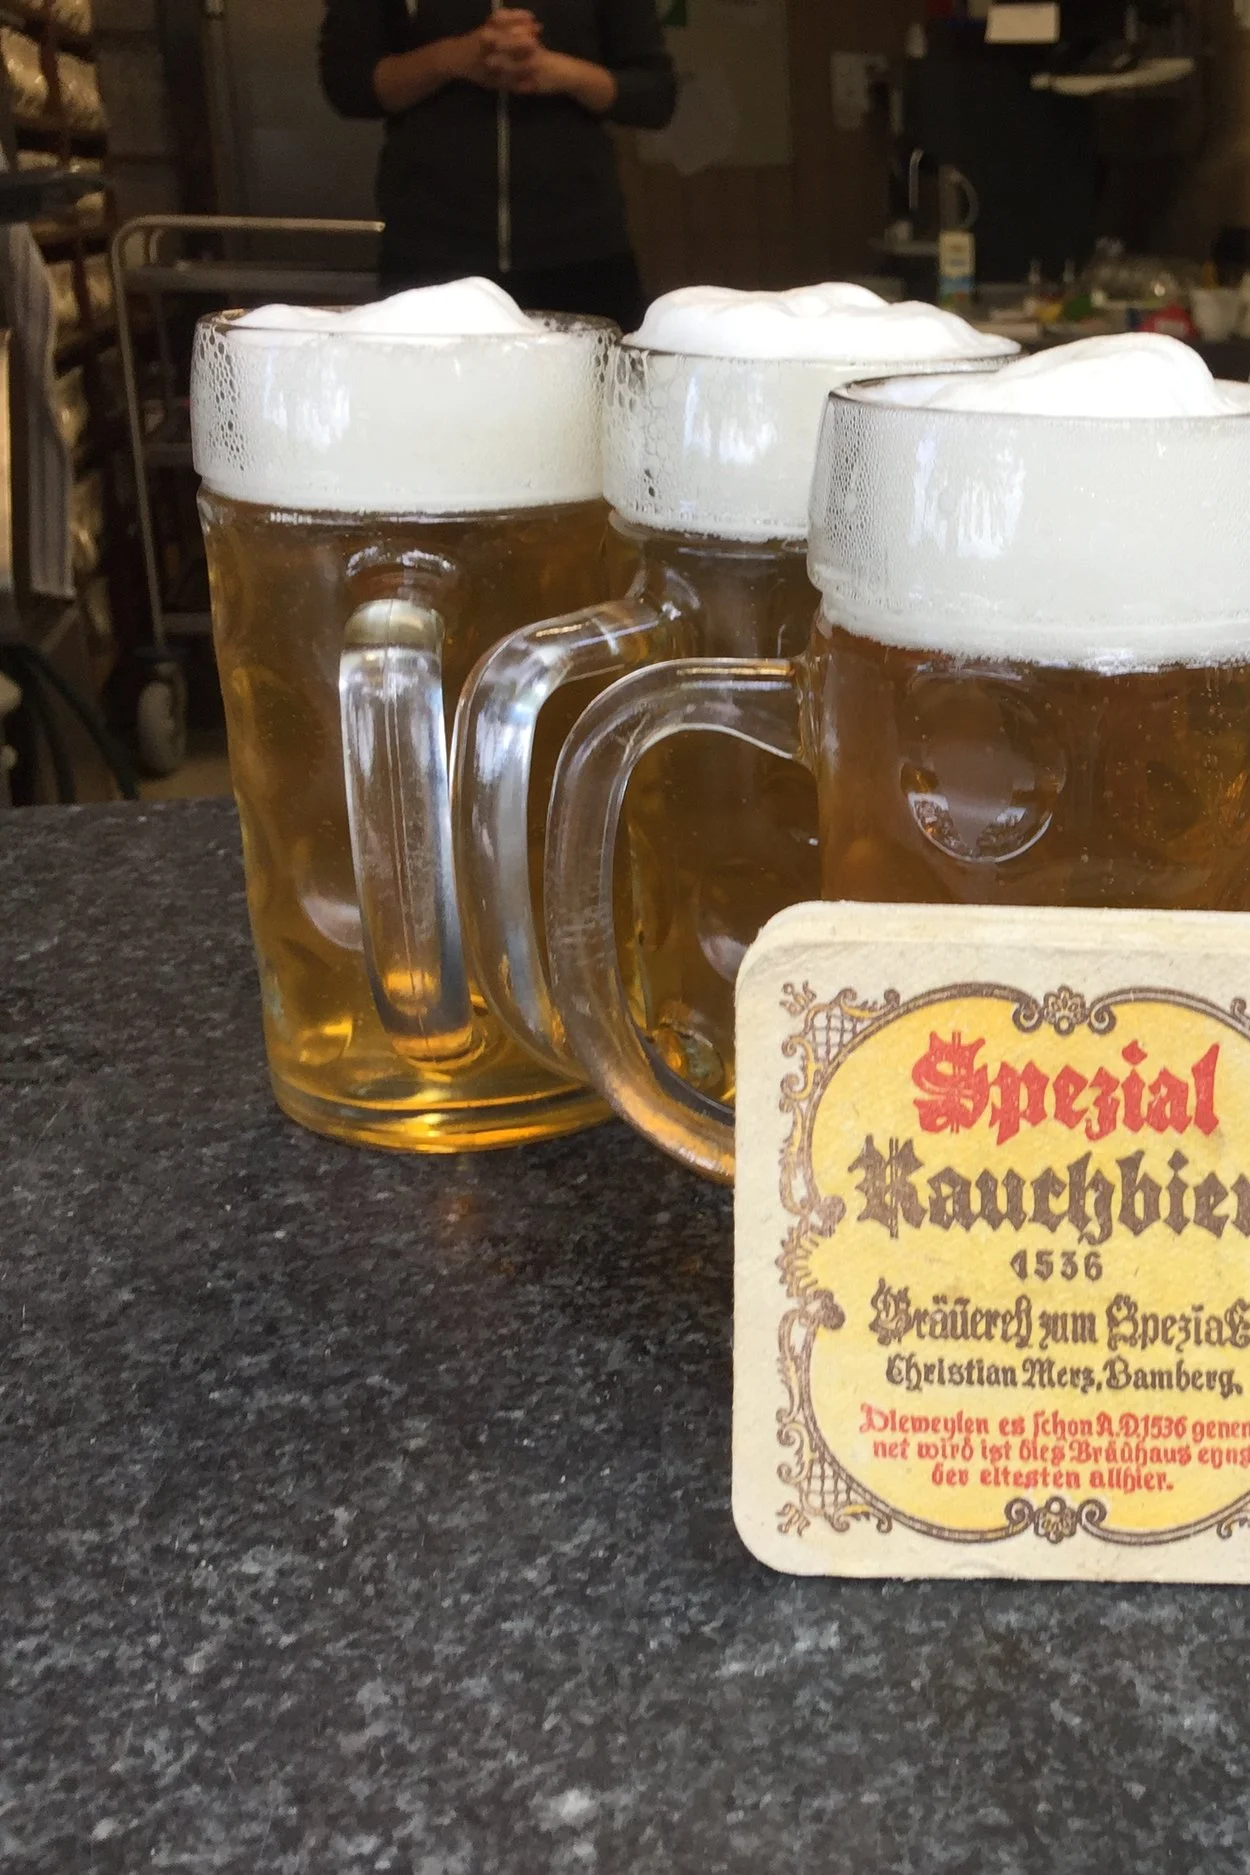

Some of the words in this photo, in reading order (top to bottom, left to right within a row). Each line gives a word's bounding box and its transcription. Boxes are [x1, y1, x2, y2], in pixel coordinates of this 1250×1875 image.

[912, 1030, 1221, 1146] Spezial
[1010, 1249, 1103, 1281] 1536
[1038, 1309, 1098, 1351] zum
[885, 1351, 1018, 1392] Christian
